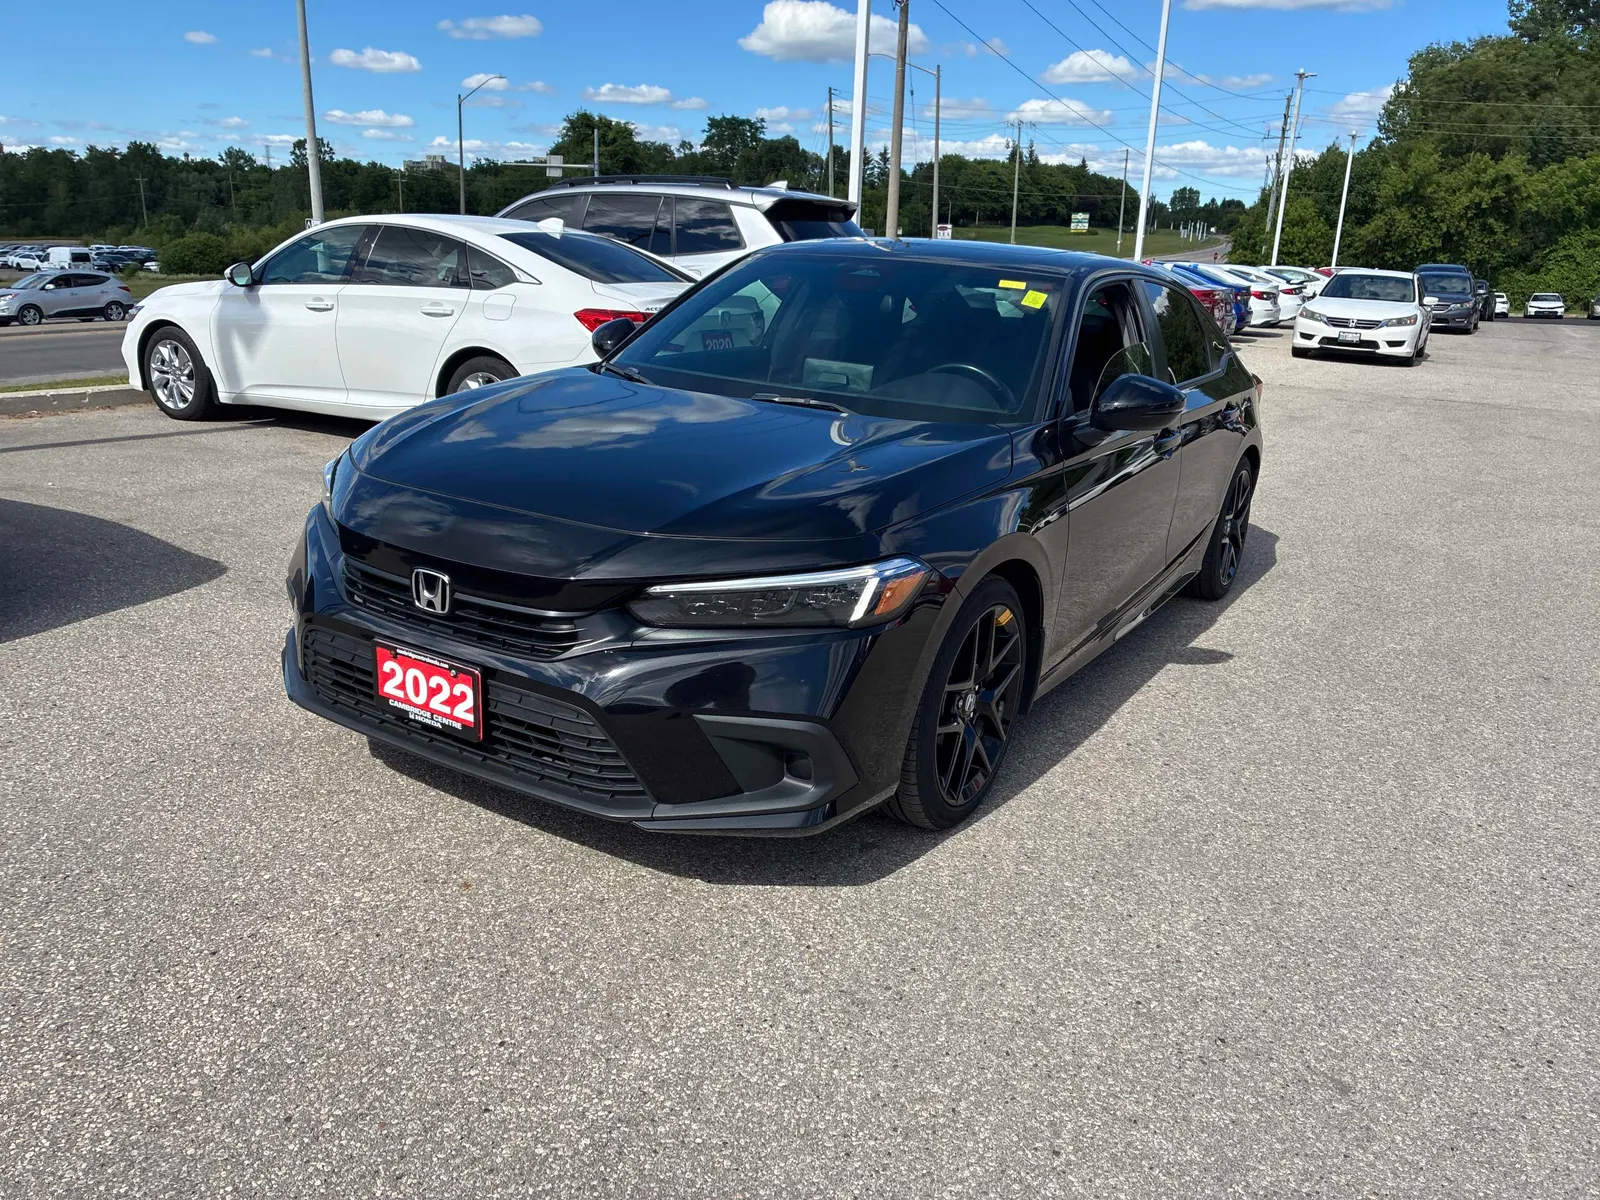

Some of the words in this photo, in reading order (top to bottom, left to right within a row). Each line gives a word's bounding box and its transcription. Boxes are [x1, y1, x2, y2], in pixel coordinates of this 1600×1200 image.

[382, 660, 474, 722] 2022
[389, 699, 432, 719] CAMBRIDGE
[433, 714, 462, 730] CENTRE
[415, 714, 442, 728] HONDA
